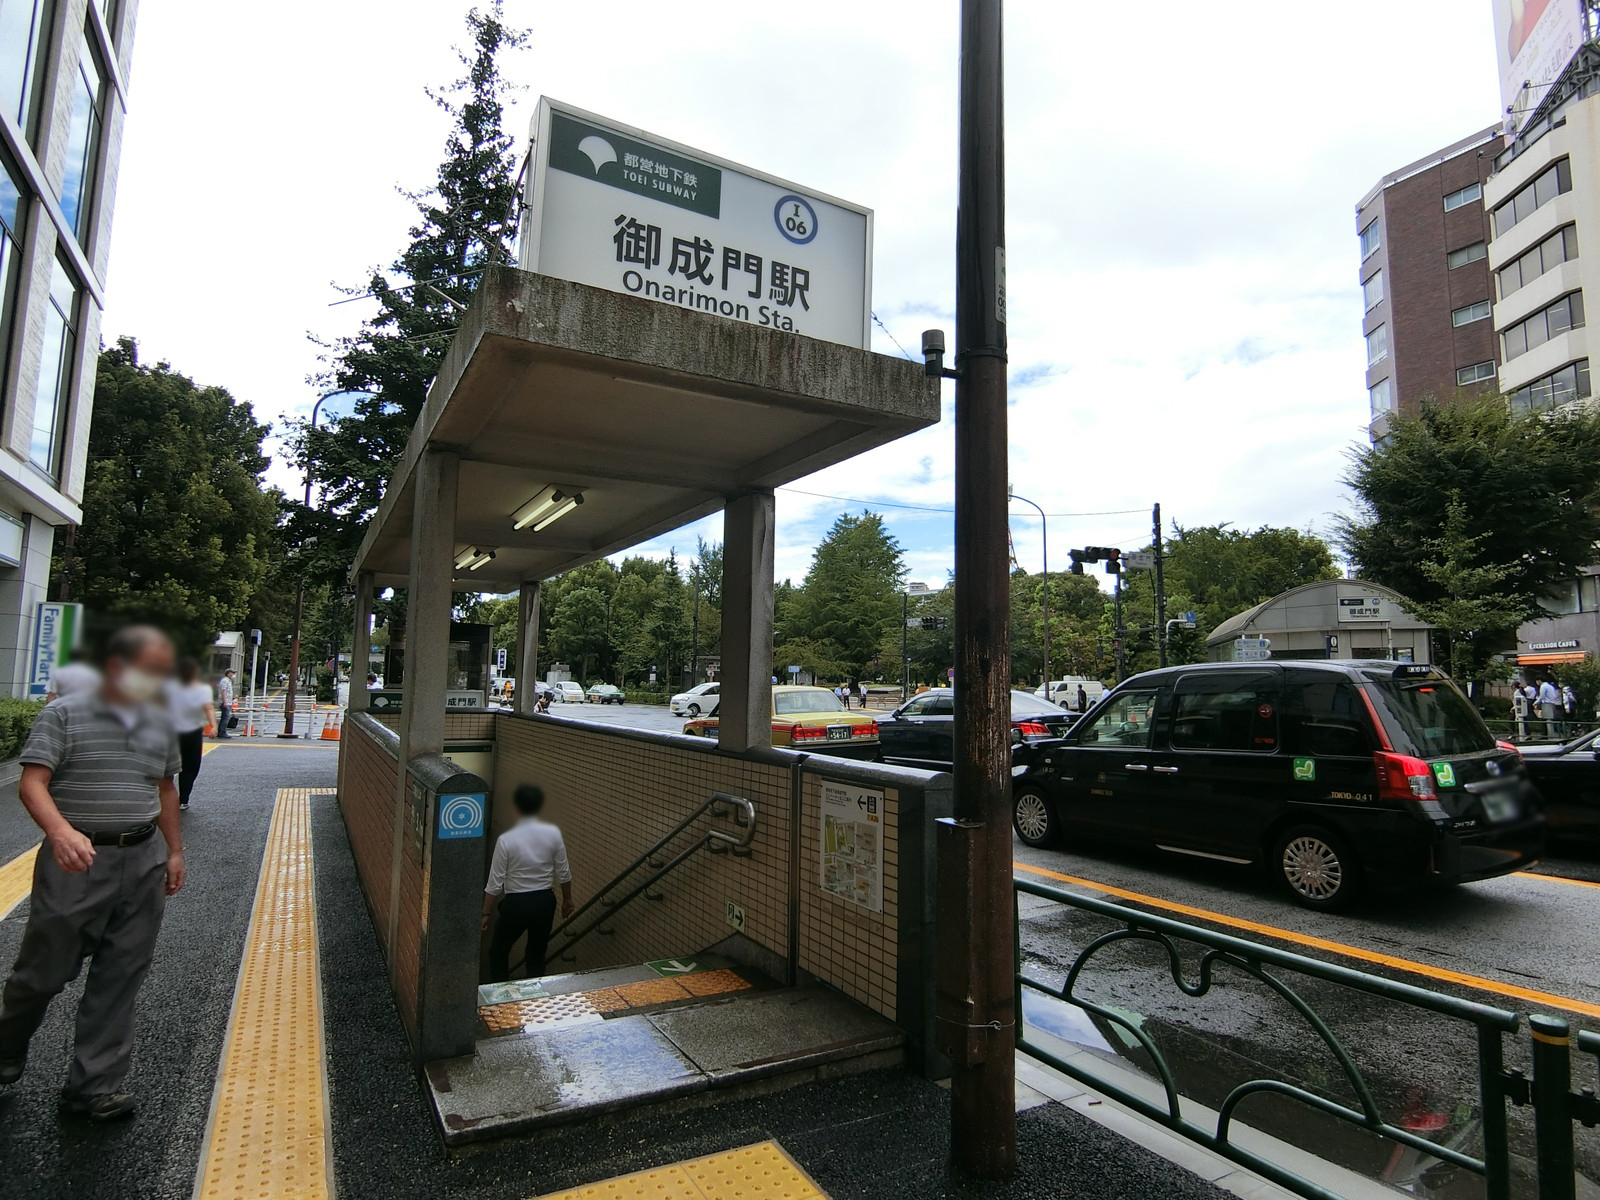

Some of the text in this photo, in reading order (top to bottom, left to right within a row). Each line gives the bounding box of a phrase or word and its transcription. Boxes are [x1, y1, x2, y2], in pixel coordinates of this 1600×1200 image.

[623, 152, 698, 188] 都営地下鉄
[623, 169, 697, 201] TOEI SUBWAY
[785, 216, 807, 236] 06
[793, 203, 801, 217] I
[613, 213, 810, 312] 御成門駅
[622, 269, 800, 334] Onarimon Sta.
[38, 608, 59, 681] FamilyMart
[1331, 791, 1351, 799] TOKYO
